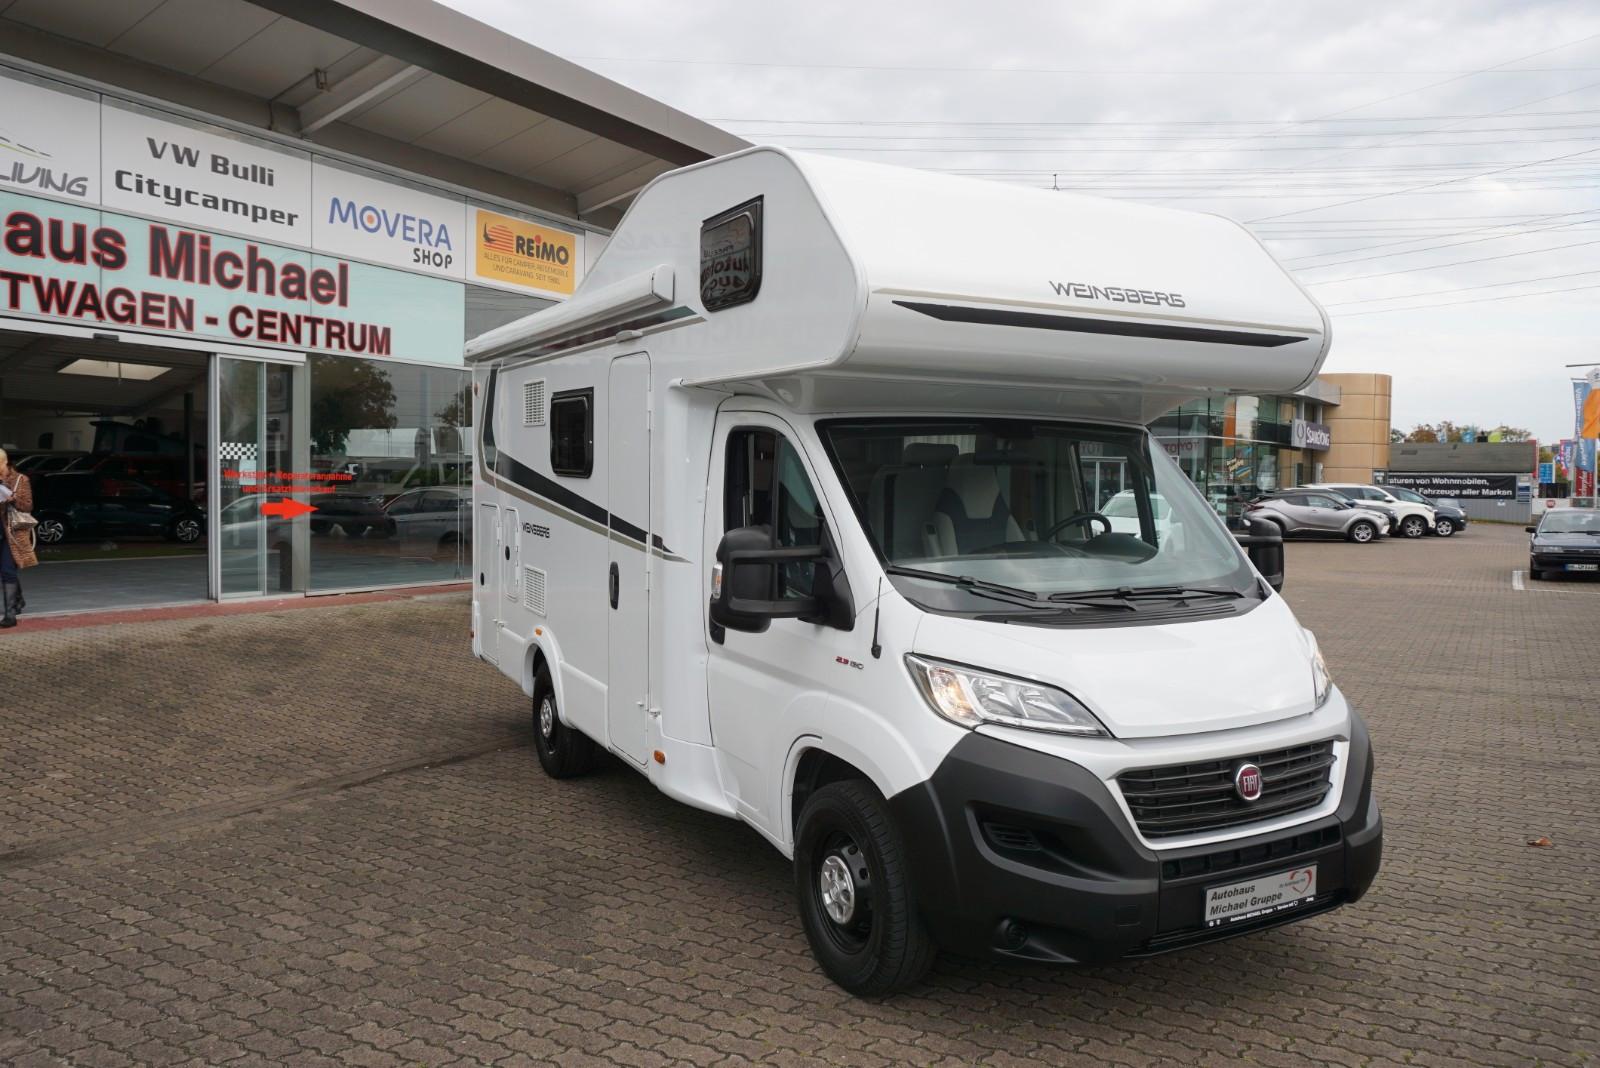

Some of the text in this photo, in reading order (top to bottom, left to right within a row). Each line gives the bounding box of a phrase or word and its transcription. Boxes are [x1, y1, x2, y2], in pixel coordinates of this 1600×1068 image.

[147, 137, 275, 187] VW Bulli
[115, 170, 299, 226] Citycamper
[328, 197, 452, 251] MOVERA
[4, 210, 349, 308] aus Michael
[413, 247, 453, 269] SHOP
[1049, 280, 1186, 308] WEINSBERG
[228, 305, 392, 356] CENTRUM
[1243, 774, 1258, 792] FIAT
[1209, 892, 1283, 916] Michael Gruppe
[1210, 885, 1256, 902] Autohaus
